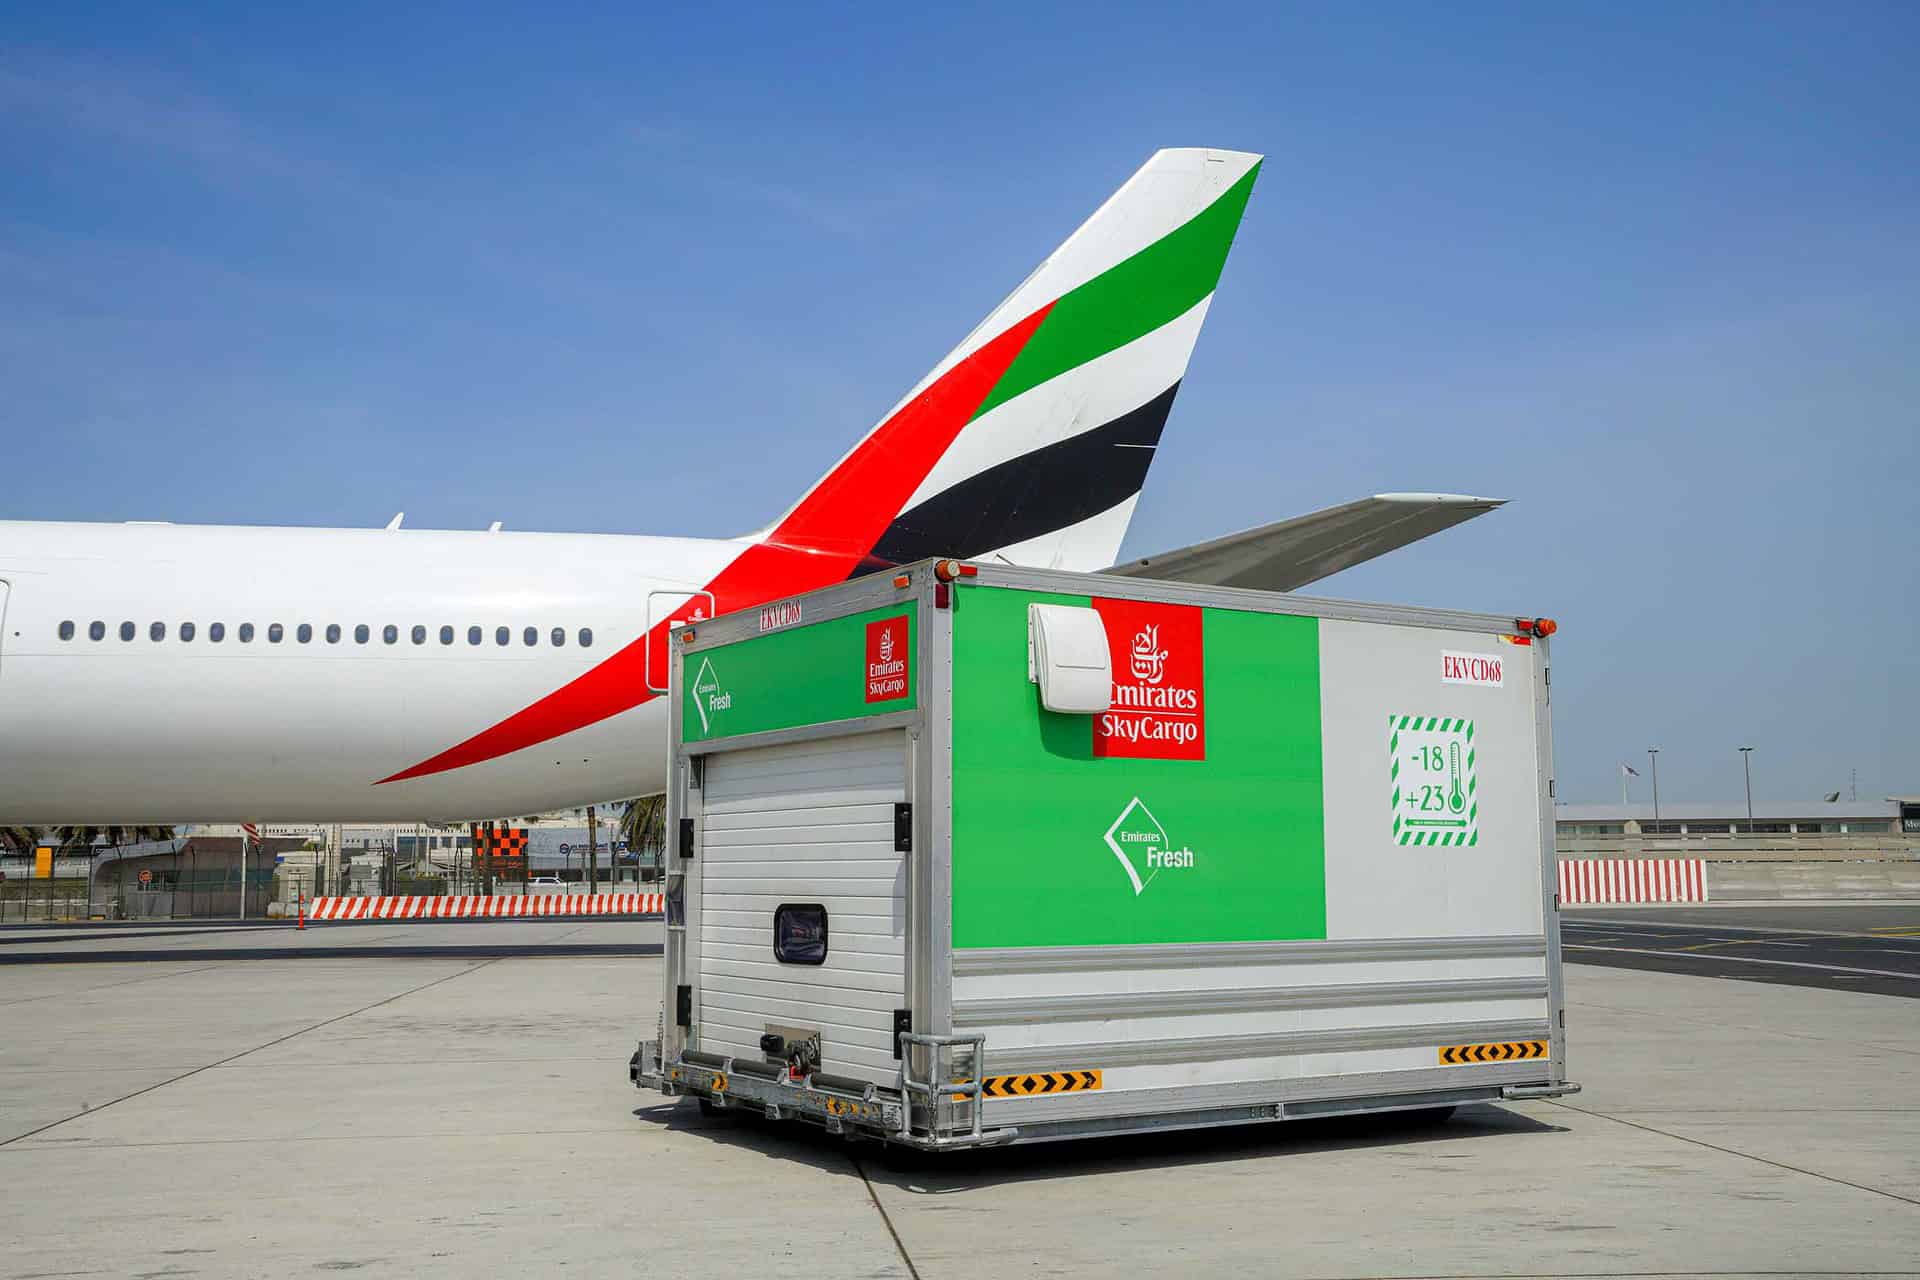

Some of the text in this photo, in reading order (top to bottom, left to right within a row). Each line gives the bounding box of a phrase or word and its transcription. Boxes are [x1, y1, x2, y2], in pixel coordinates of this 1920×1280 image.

[870, 660, 904, 677] Emirates
[1444, 655, 1502, 682] EKVCD68
[870, 679, 904, 696] SkyCargo
[1110, 681, 1197, 709] mirates
[710, 691, 731, 712] Fresh
[1102, 715, 1197, 744] SkyCargo
[1411, 745, 1444, 771] -18
[1406, 785, 1445, 811] +23
[1121, 831, 1160, 842] Emirates
[1147, 847, 1193, 868] Fresh
